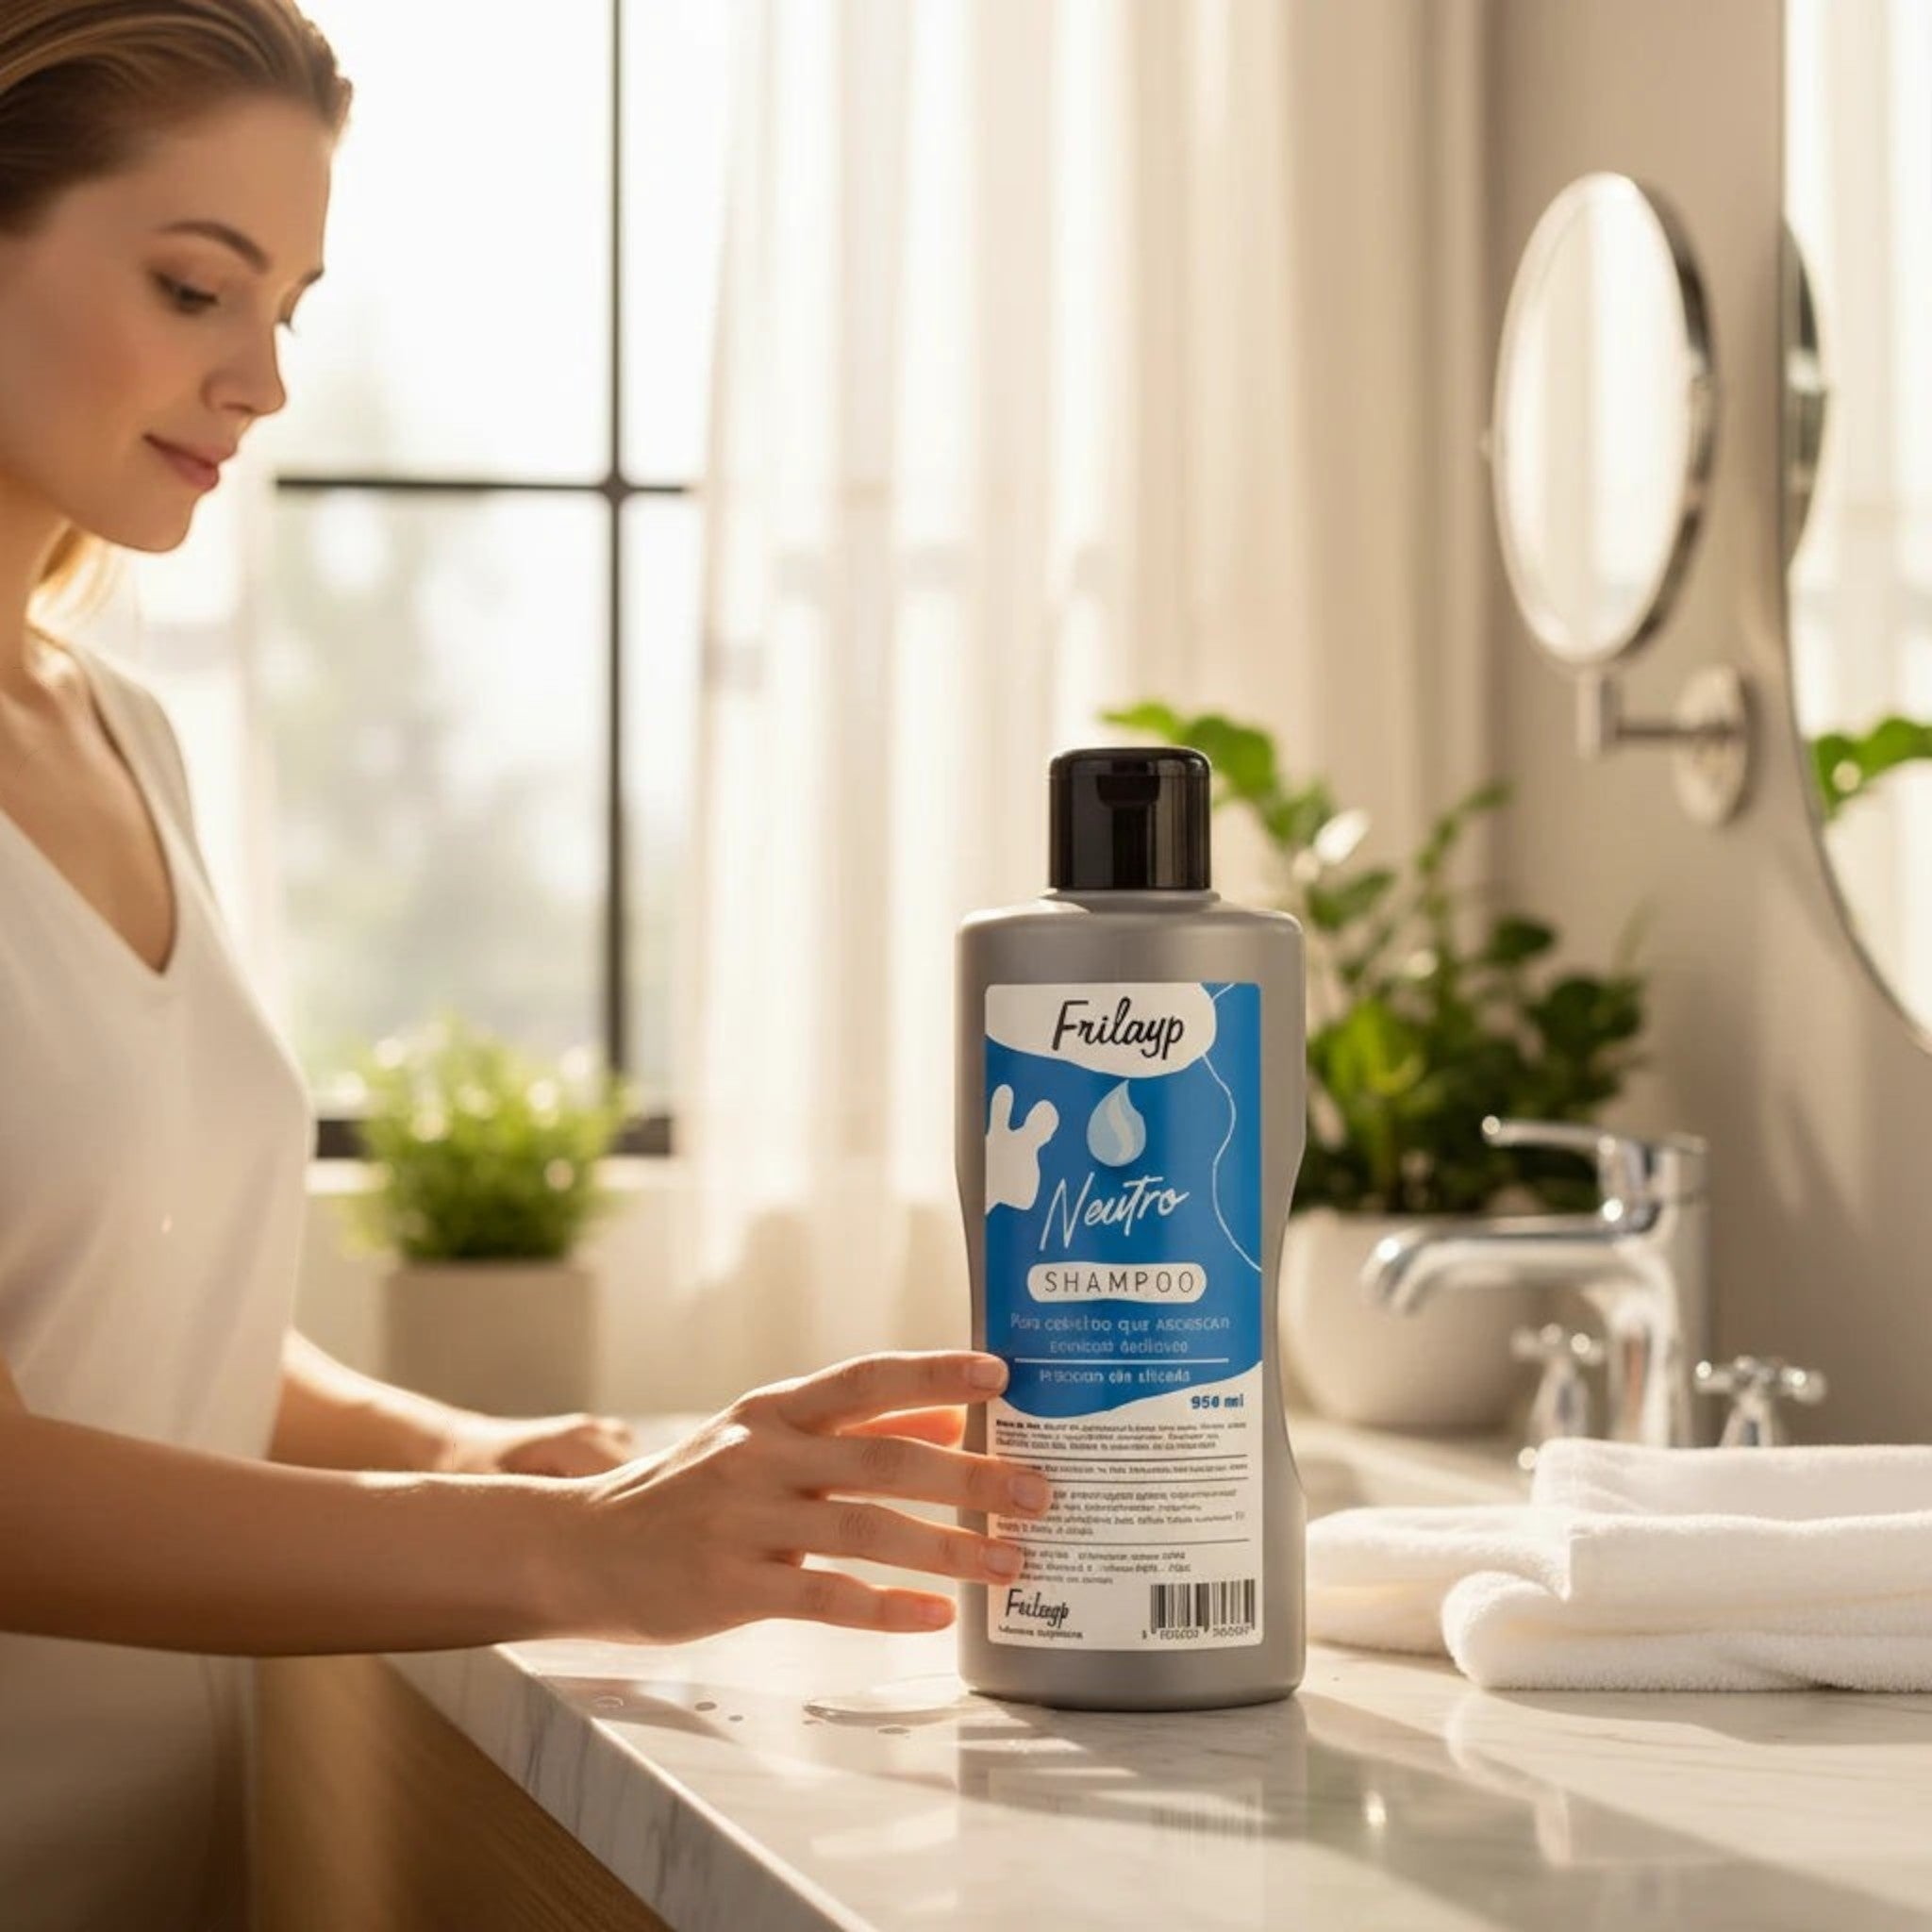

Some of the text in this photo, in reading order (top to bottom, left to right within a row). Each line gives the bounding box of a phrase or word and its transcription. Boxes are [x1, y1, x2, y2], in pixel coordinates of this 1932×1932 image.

[1052, 996, 1185, 1060] Frilayp
[1039, 1171, 1190, 1251] Neutro
[1043, 1271, 1195, 1293] SHAMPOO
